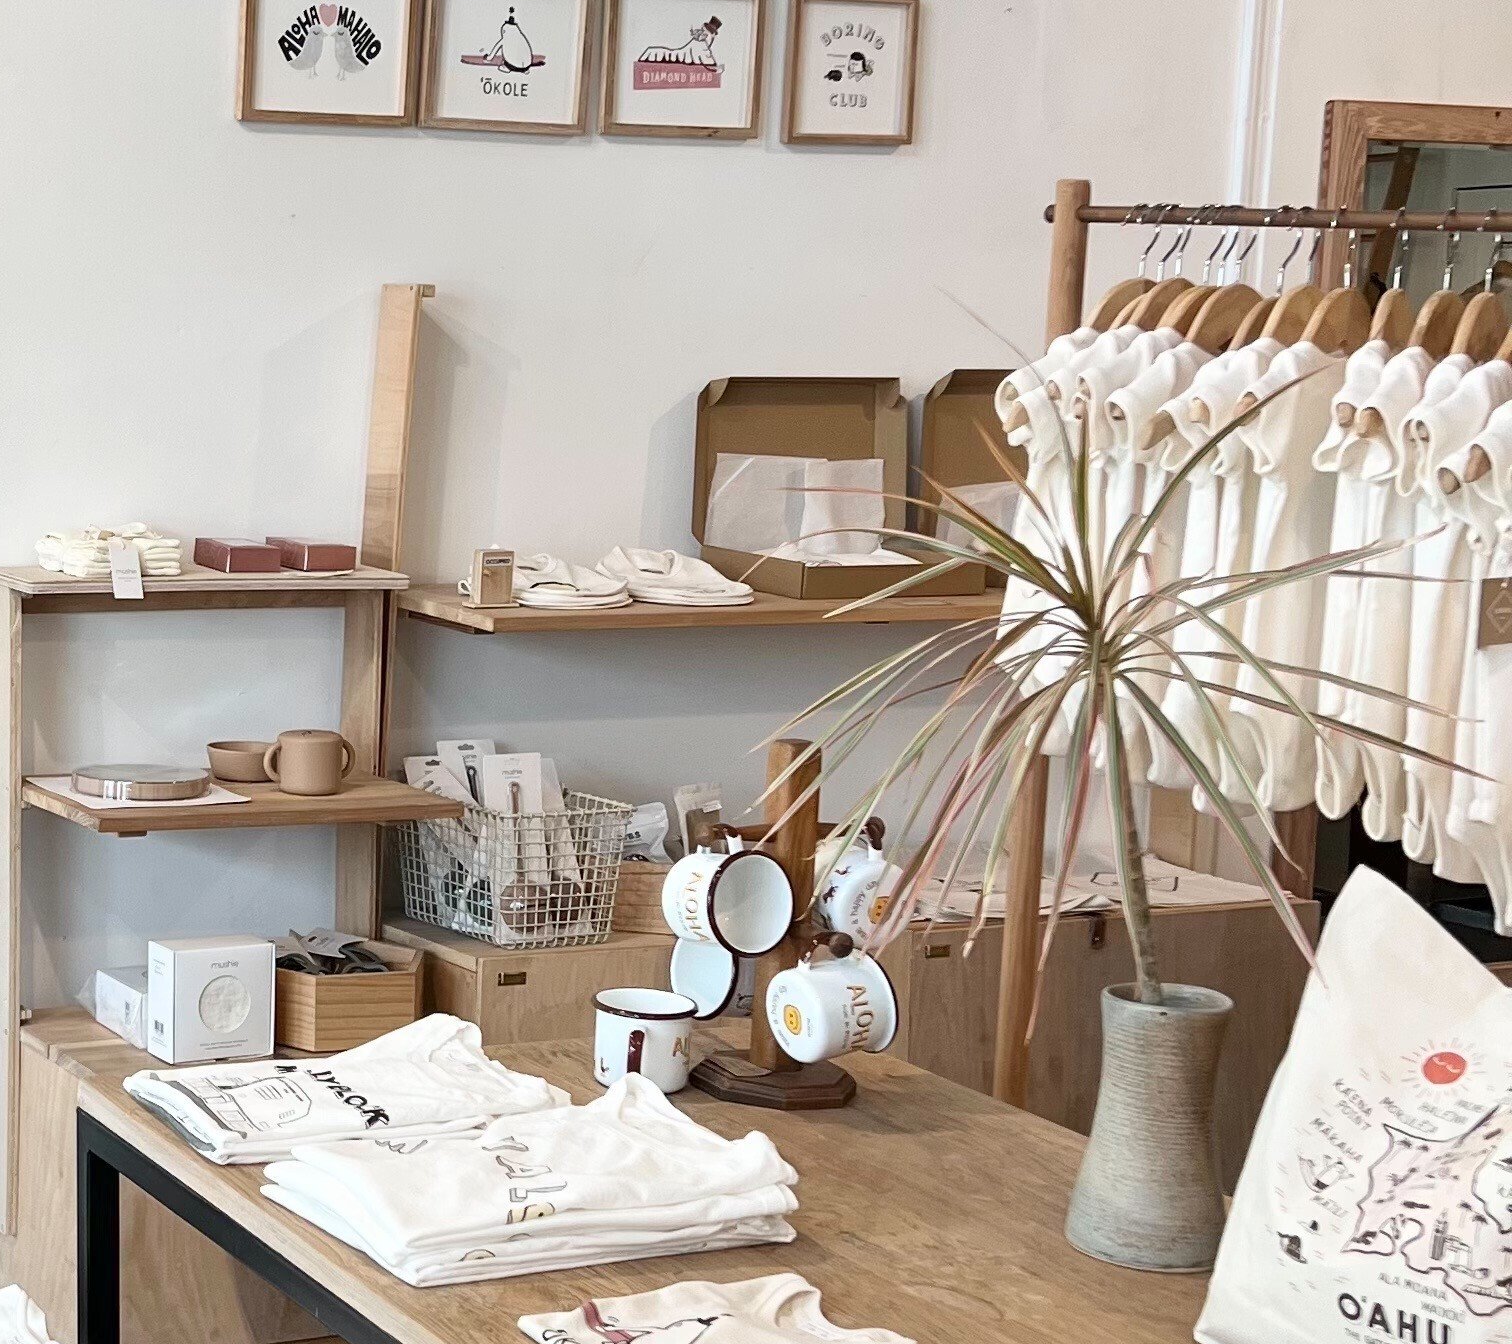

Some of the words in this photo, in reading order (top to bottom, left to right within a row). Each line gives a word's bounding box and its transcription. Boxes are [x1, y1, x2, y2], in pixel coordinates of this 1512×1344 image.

[277, 5, 321, 62] ALOHA
[337, 5, 382, 66] MAHALO
[829, 92, 868, 108] CLUB
